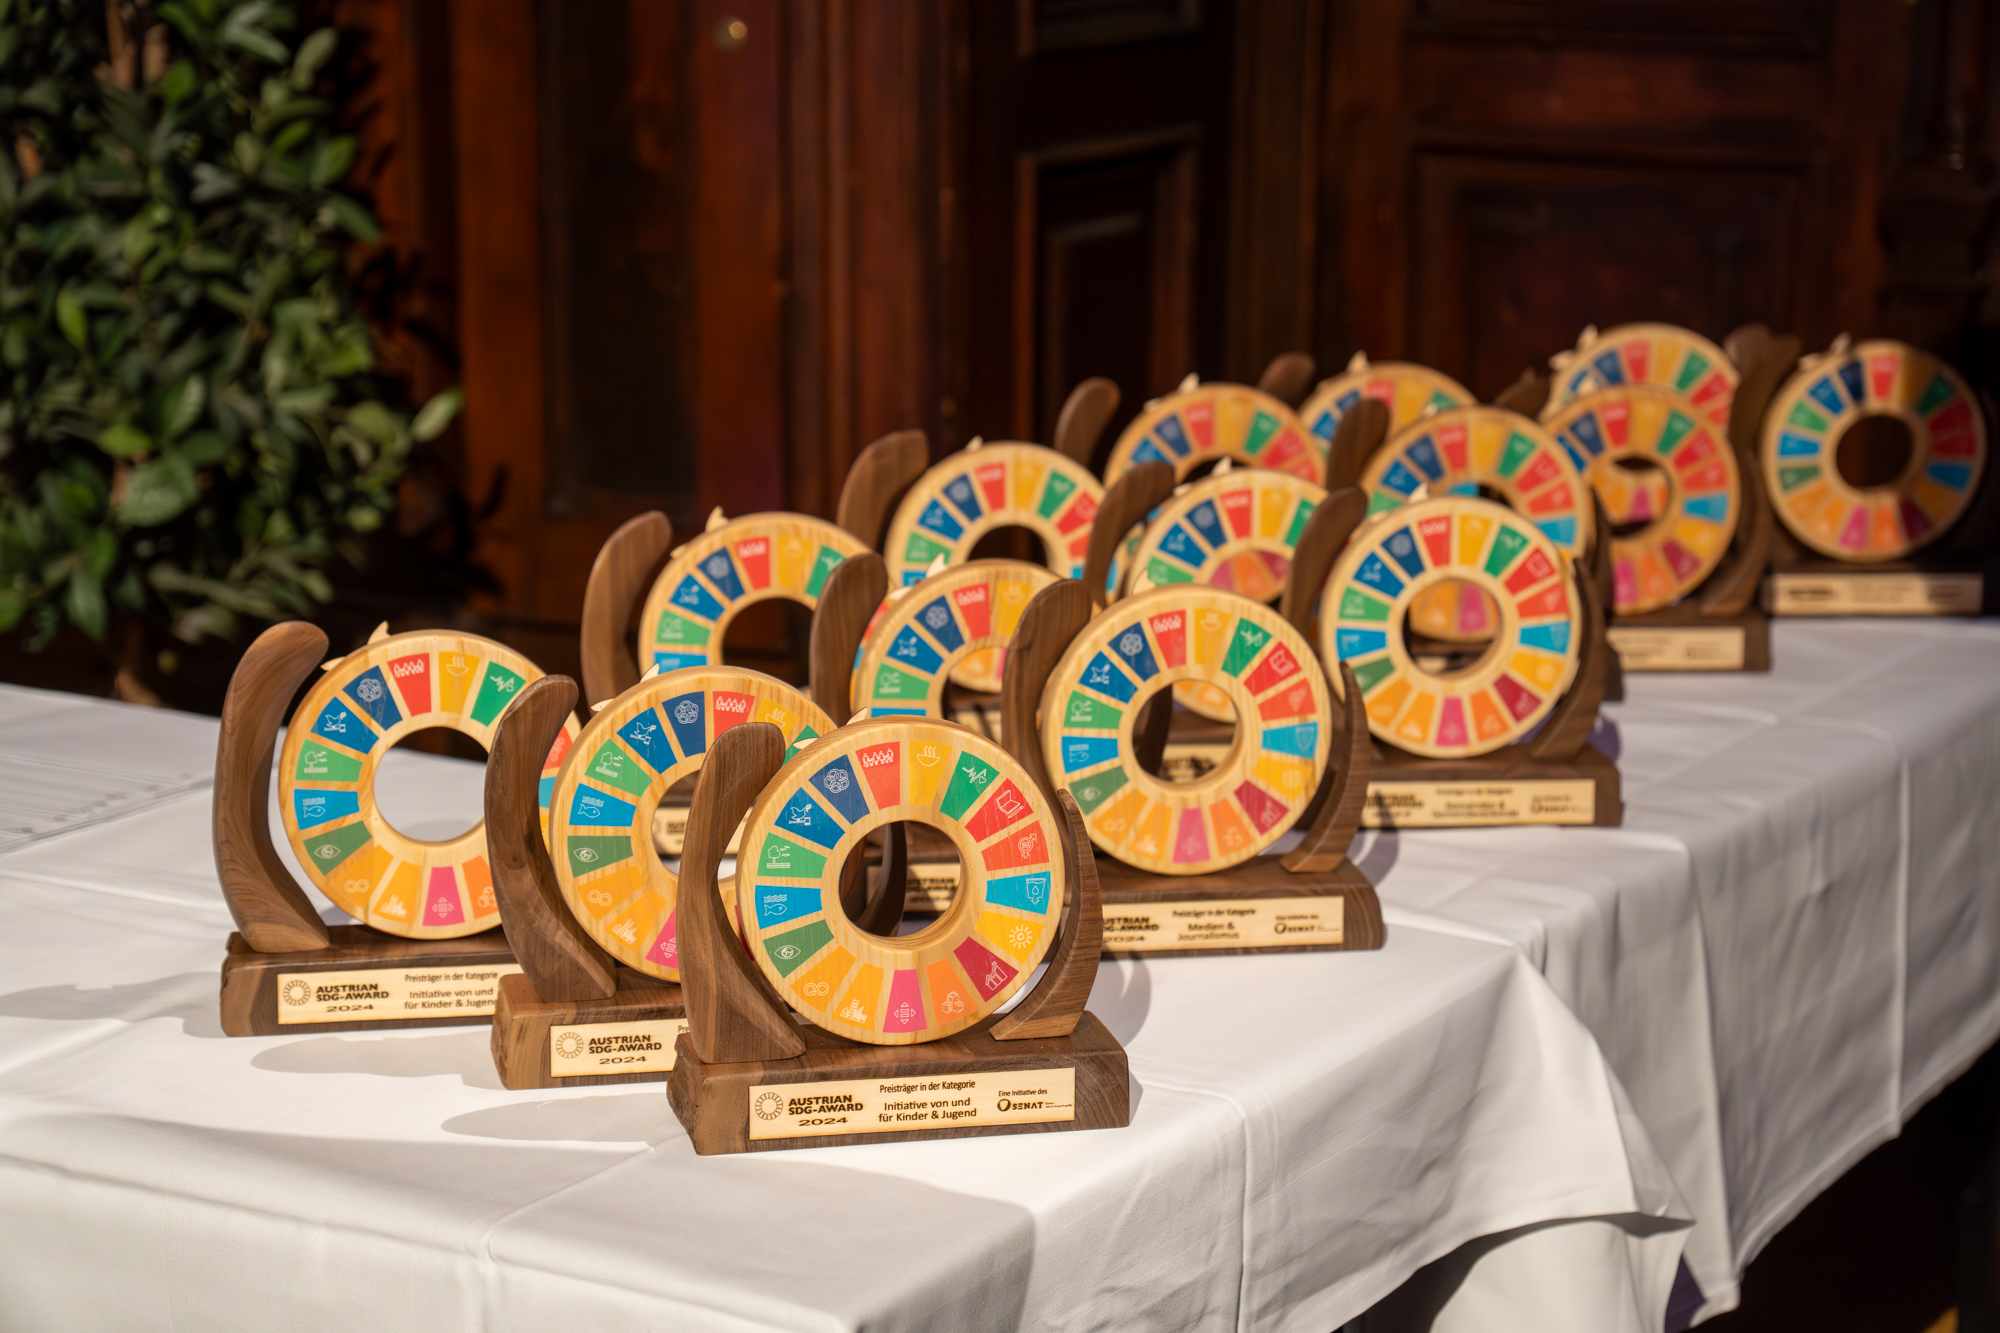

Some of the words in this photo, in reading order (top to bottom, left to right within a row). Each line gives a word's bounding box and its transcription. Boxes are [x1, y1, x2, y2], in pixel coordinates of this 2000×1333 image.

[1103, 916, 1149, 925] USTRIAN
[1188, 922, 1224, 931] Medien
[1227, 922, 1235, 930] &
[1178, 932, 1240, 942] Journalismus
[404, 973, 442, 984] Preisträger
[444, 972, 451, 981] in
[452, 971, 464, 981] der
[465, 970, 498, 982] Kategorie
[316, 984, 379, 994] AUSTRIAN
[409, 989, 452, 999] Initiative
[454, 990, 473, 998] von
[475, 987, 494, 997] und
[316, 991, 389, 1002] SDG-AWARD
[326, 1004, 375, 1013] 2024
[404, 1001, 418, 1010] für
[421, 1000, 452, 1009] Kinder
[455, 999, 463, 1008] &
[589, 1034, 652, 1046] AUSTRIAN
[589, 1042, 662, 1054] SDG-AWARD
[599, 1056, 648, 1065] 2024
[880, 1084, 918, 1094] Preisträger
[920, 1082, 927, 1091] in
[928, 1082, 940, 1091] der
[942, 1079, 976, 1091] Kategorie
[1012, 1088, 1037, 1096] Initiative
[788, 1094, 853, 1107] AUSTRIAN
[884, 1100, 928, 1111] Initiative
[930, 1100, 949, 1108] von
[951, 1097, 971, 1106] und
[1012, 1101, 1044, 1110] SENAT
[788, 1103, 864, 1115] SDG-AWARD
[879, 1113, 893, 1122] für
[896, 1111, 929, 1122] Kinder
[931, 1110, 939, 1119] &
[942, 1108, 977, 1120] Jugend
[798, 1117, 848, 1127] 2024
